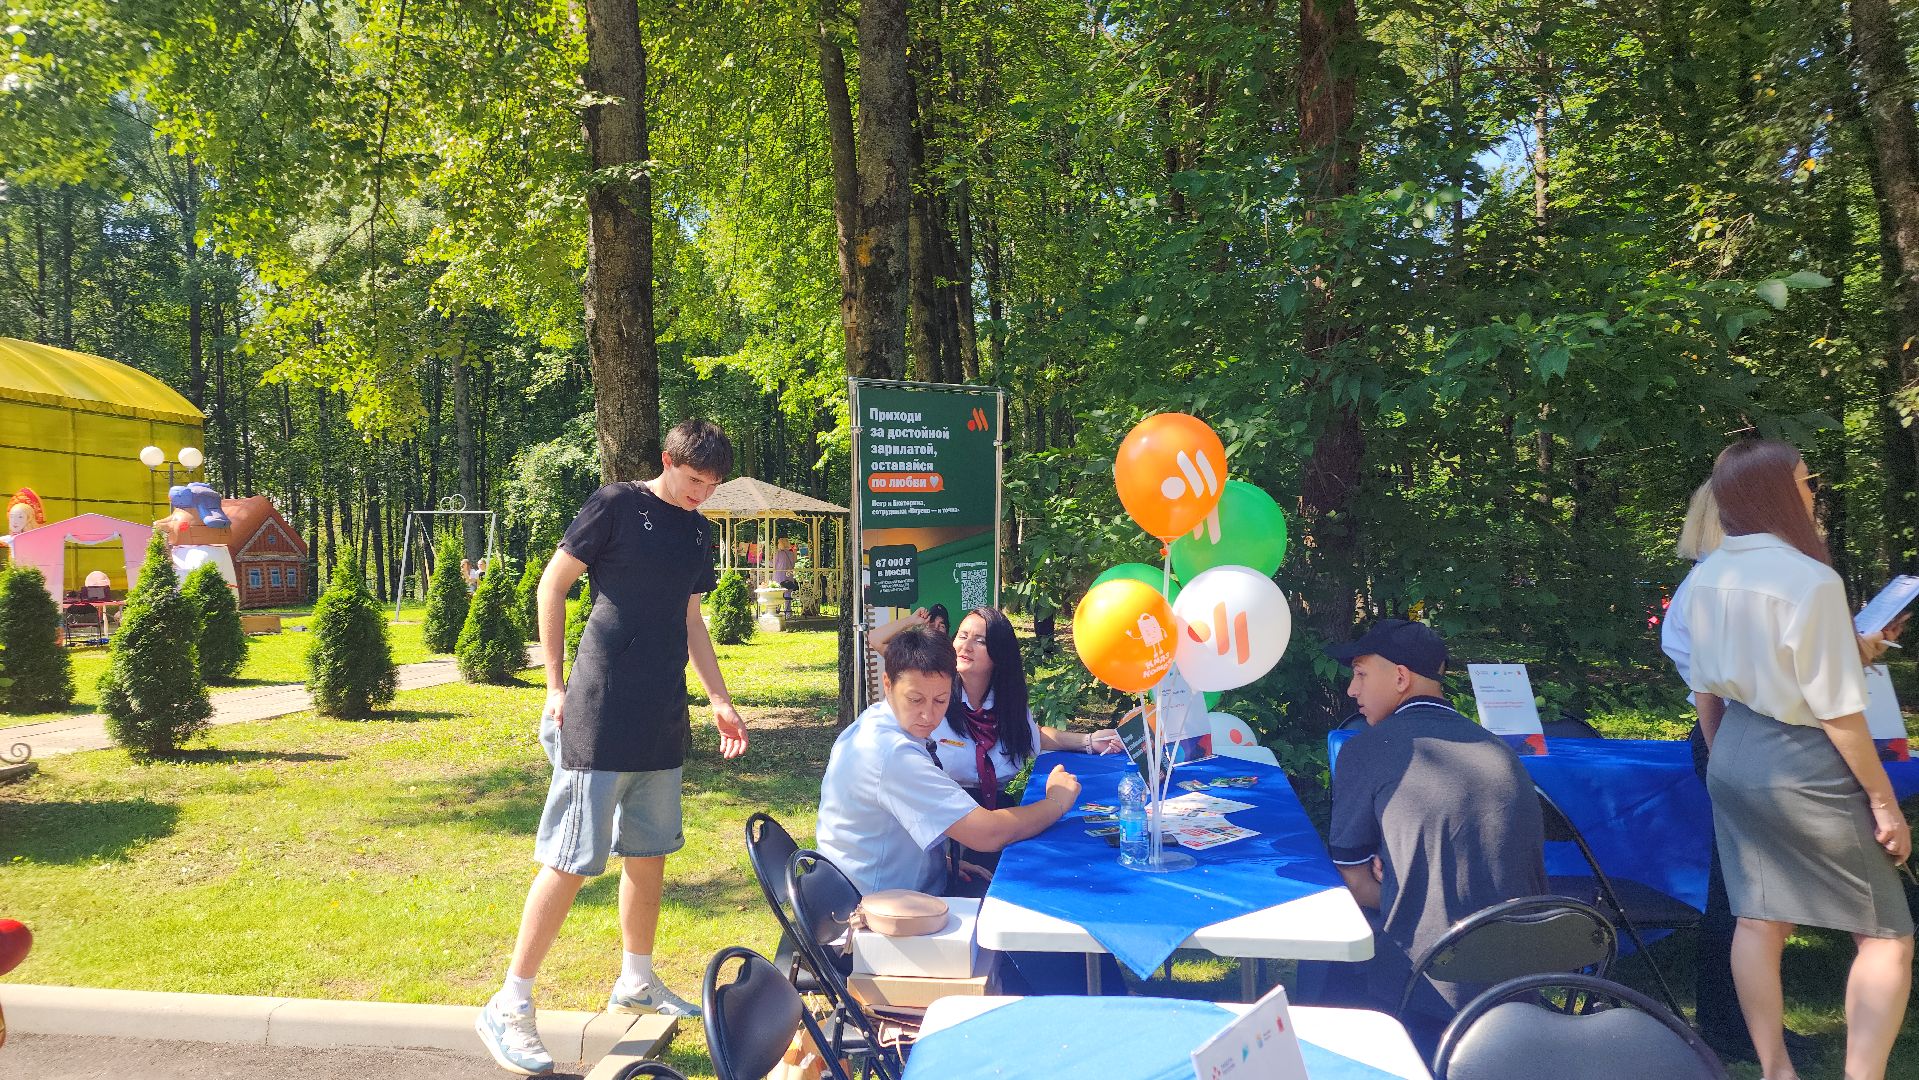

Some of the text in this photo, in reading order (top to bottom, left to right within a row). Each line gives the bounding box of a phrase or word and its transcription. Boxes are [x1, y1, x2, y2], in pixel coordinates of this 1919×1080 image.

[869, 408, 922, 423] Приходи
[870, 426, 950, 439] за достойной
[870, 443, 938, 457] зарплатой,
[871, 459, 934, 471] оставайся
[871, 476, 927, 488] по любви
[884, 568, 911, 577] месяц
